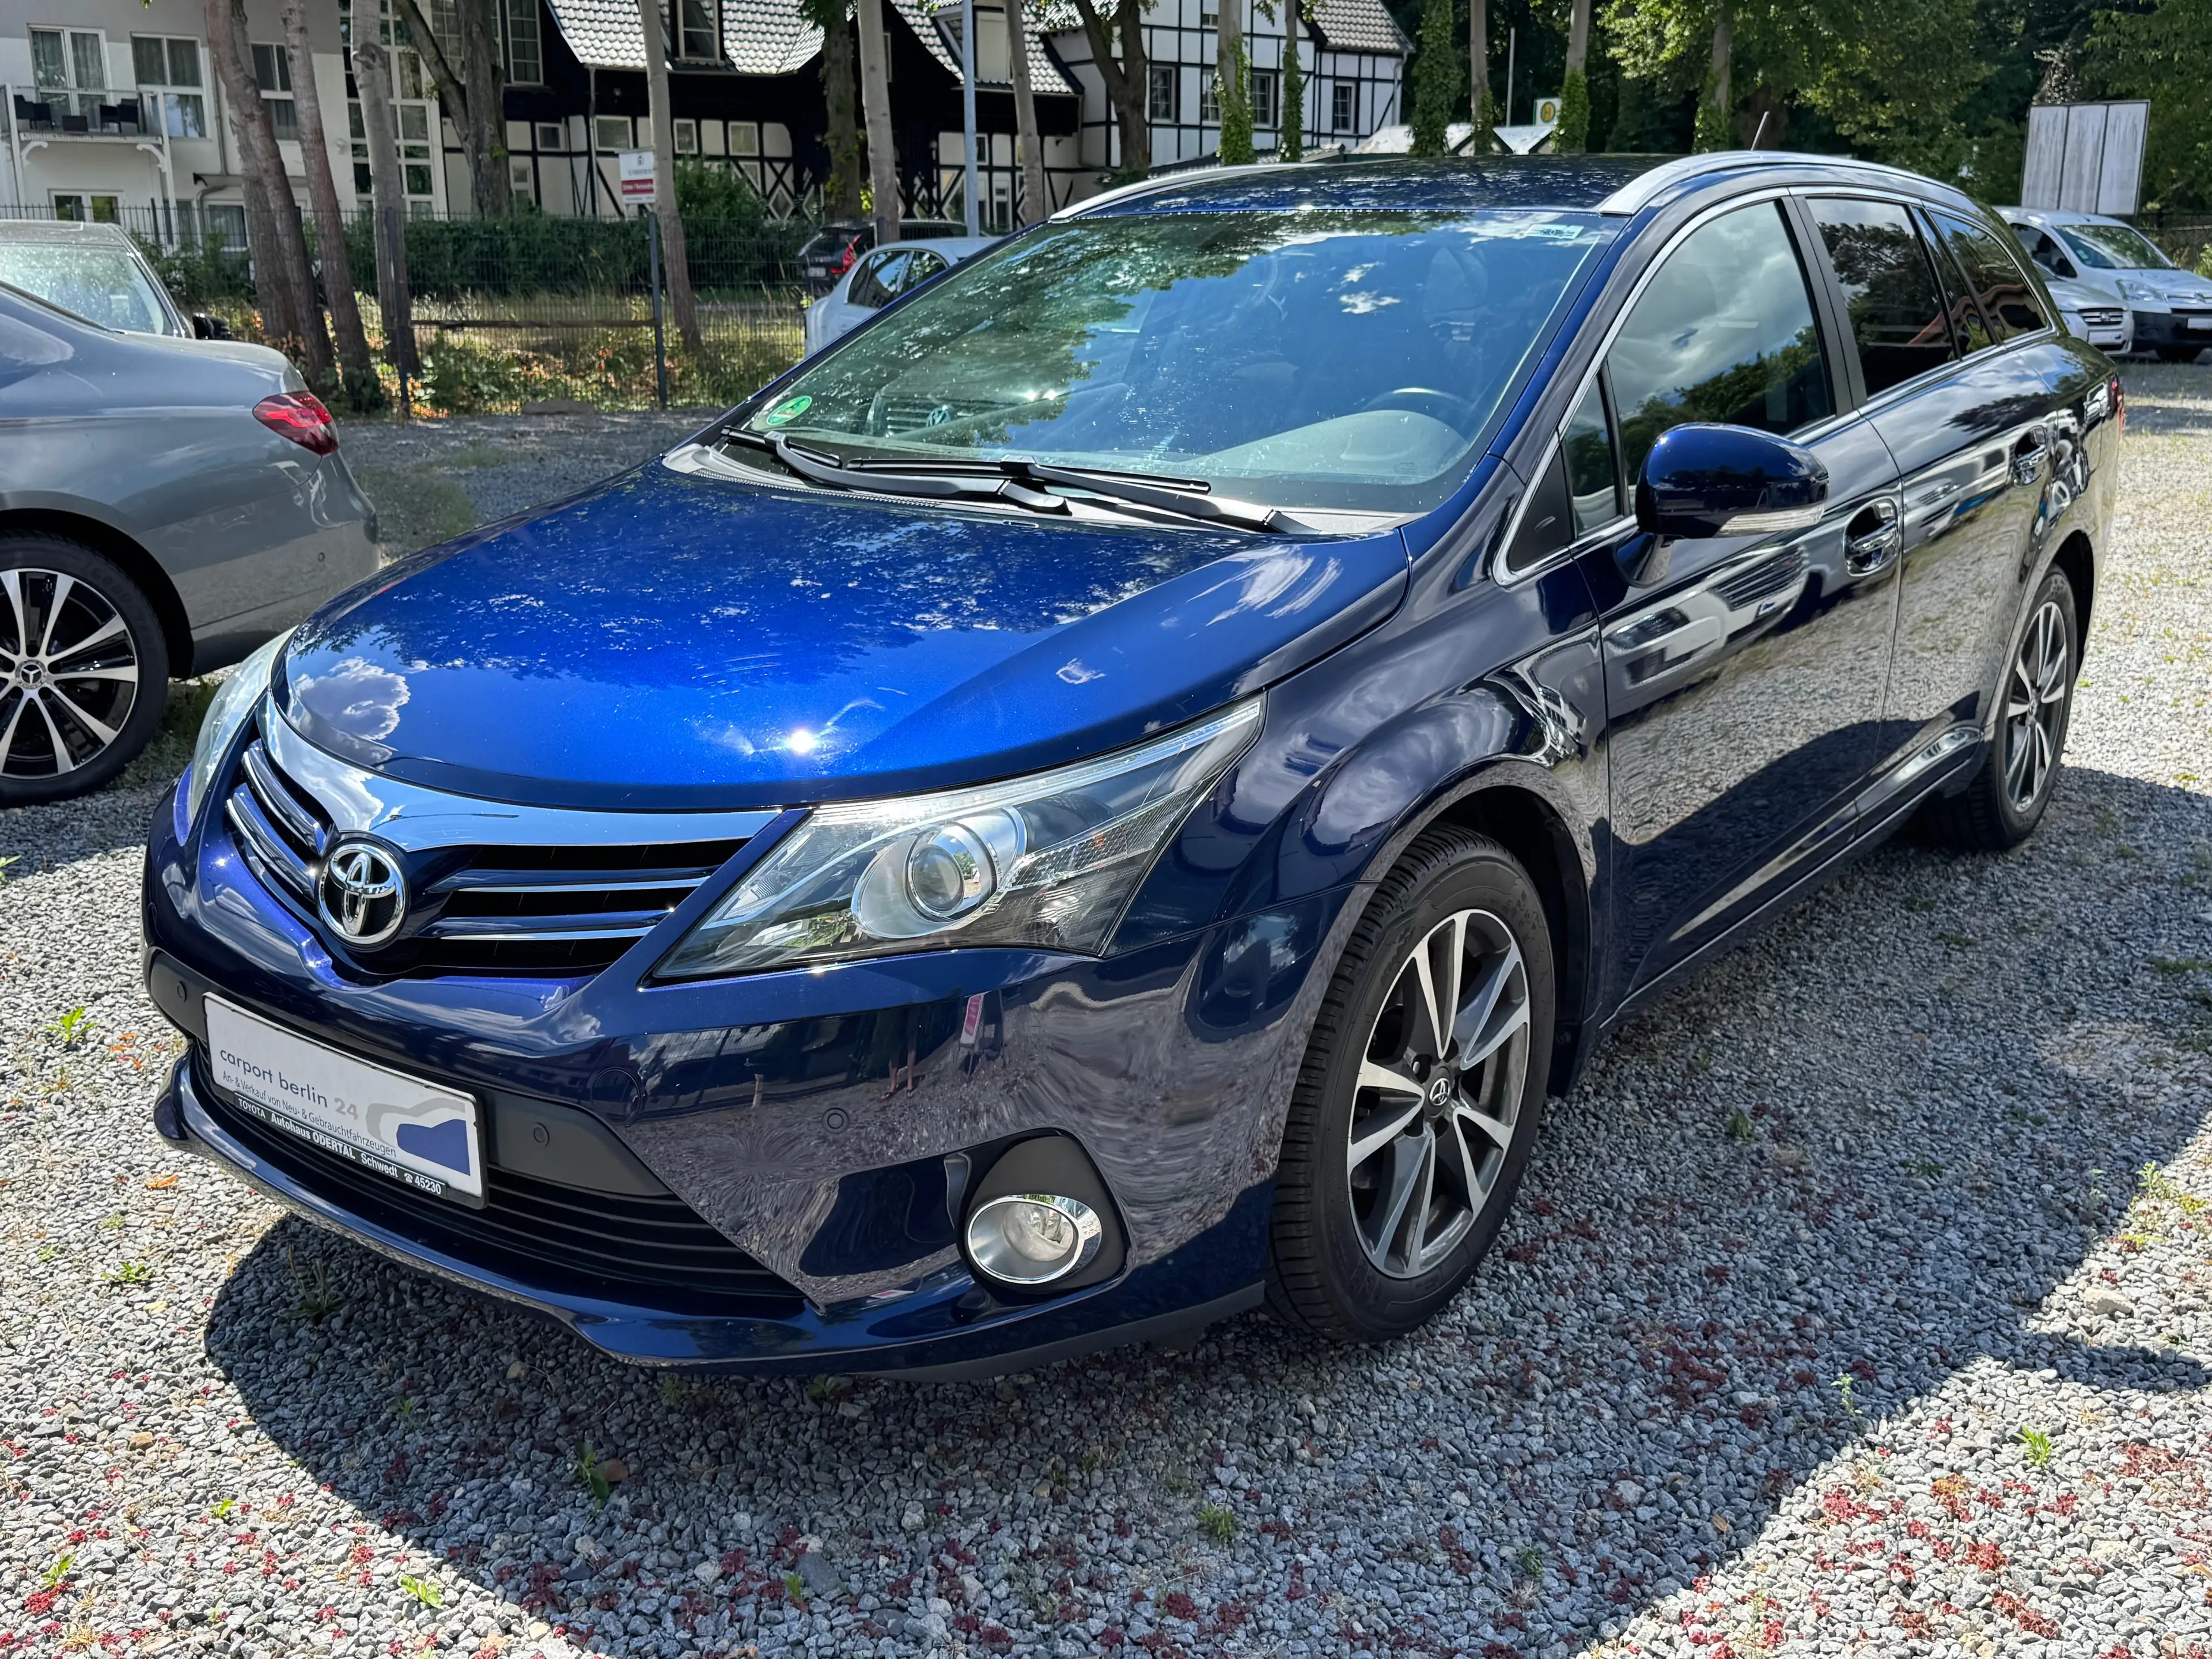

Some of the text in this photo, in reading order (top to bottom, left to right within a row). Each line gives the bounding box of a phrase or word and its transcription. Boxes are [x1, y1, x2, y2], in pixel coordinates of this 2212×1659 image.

[220, 1050, 359, 1120] carport berlin 24
[223, 1070, 396, 1158] An- & Verkauf von Neu- & Gebrauchtfahrzeugen
[238, 1098, 441, 1195] TOYOTA Autohaus ODERTAL Schwedt 45230
